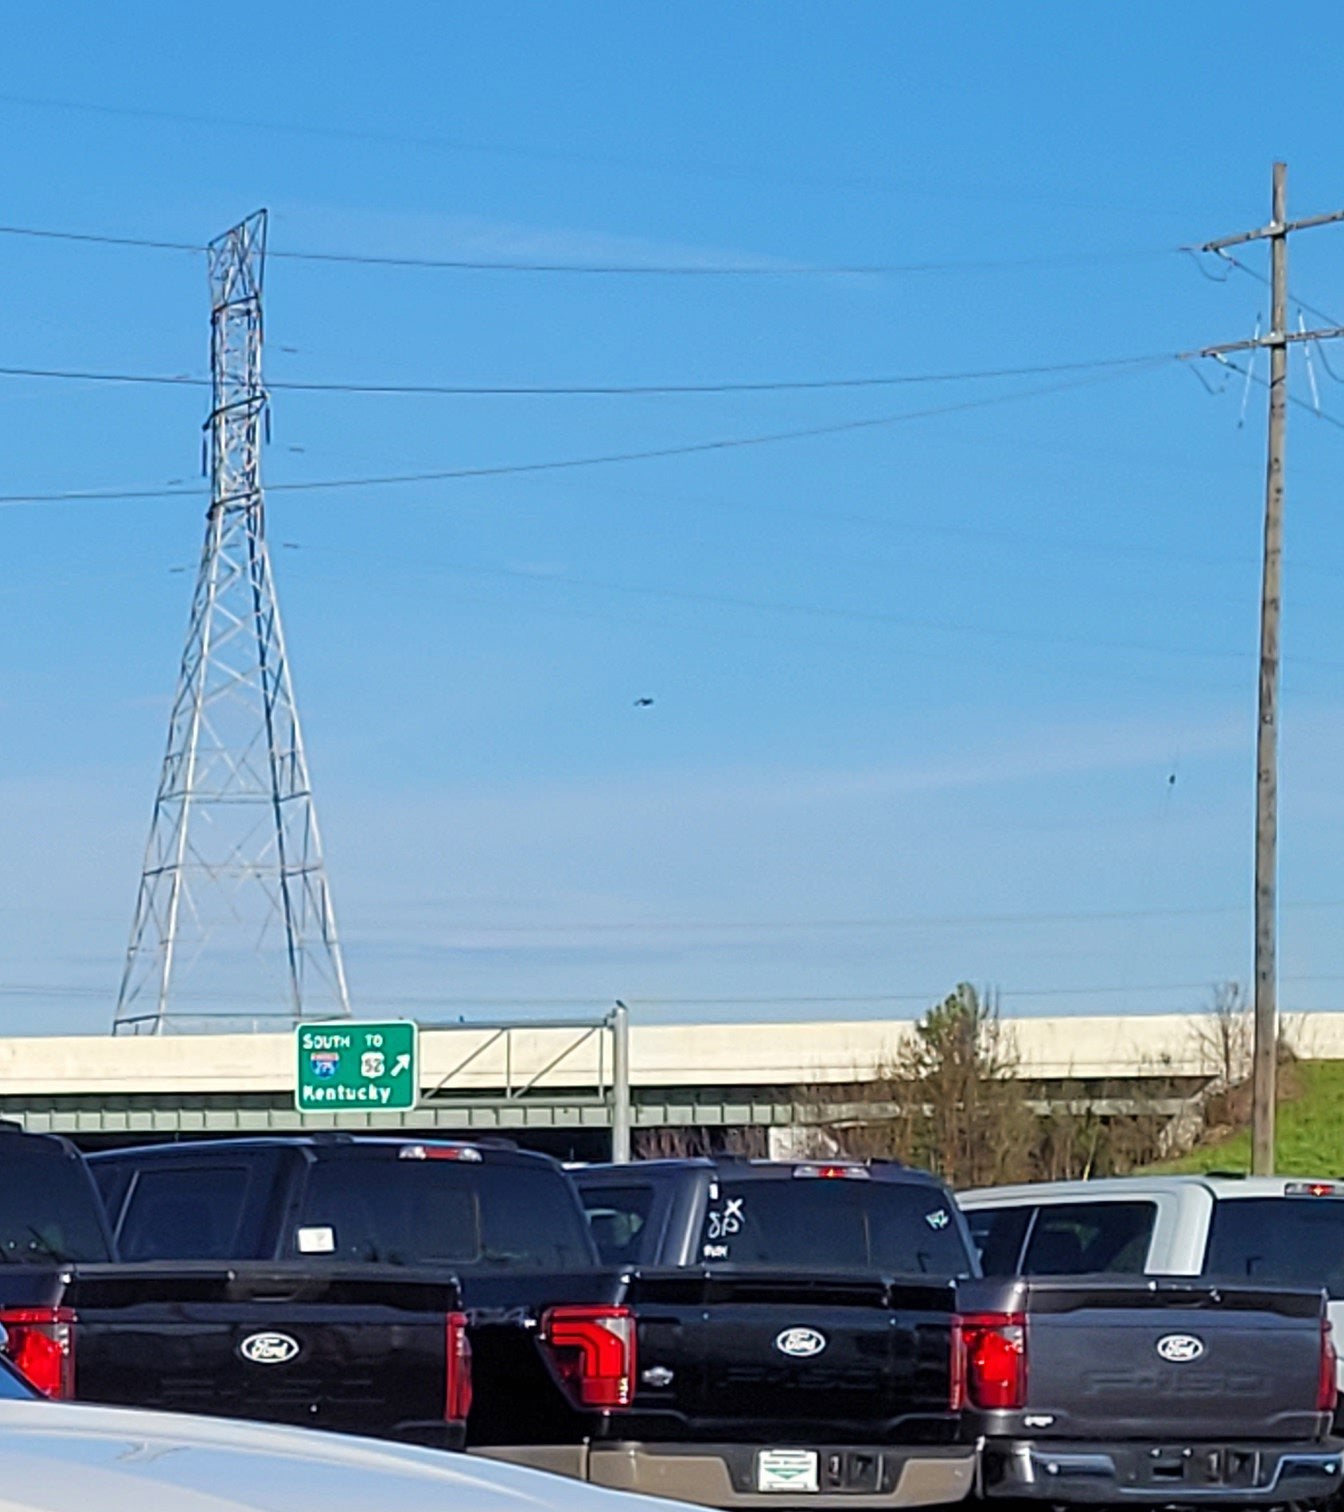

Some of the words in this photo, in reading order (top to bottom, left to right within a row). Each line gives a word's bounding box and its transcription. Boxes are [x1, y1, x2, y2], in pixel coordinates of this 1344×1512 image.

[302, 1033, 351, 1049] SOUTH
[302, 1084, 391, 1104] Kentucky
[251, 1338, 288, 1360] Ford
